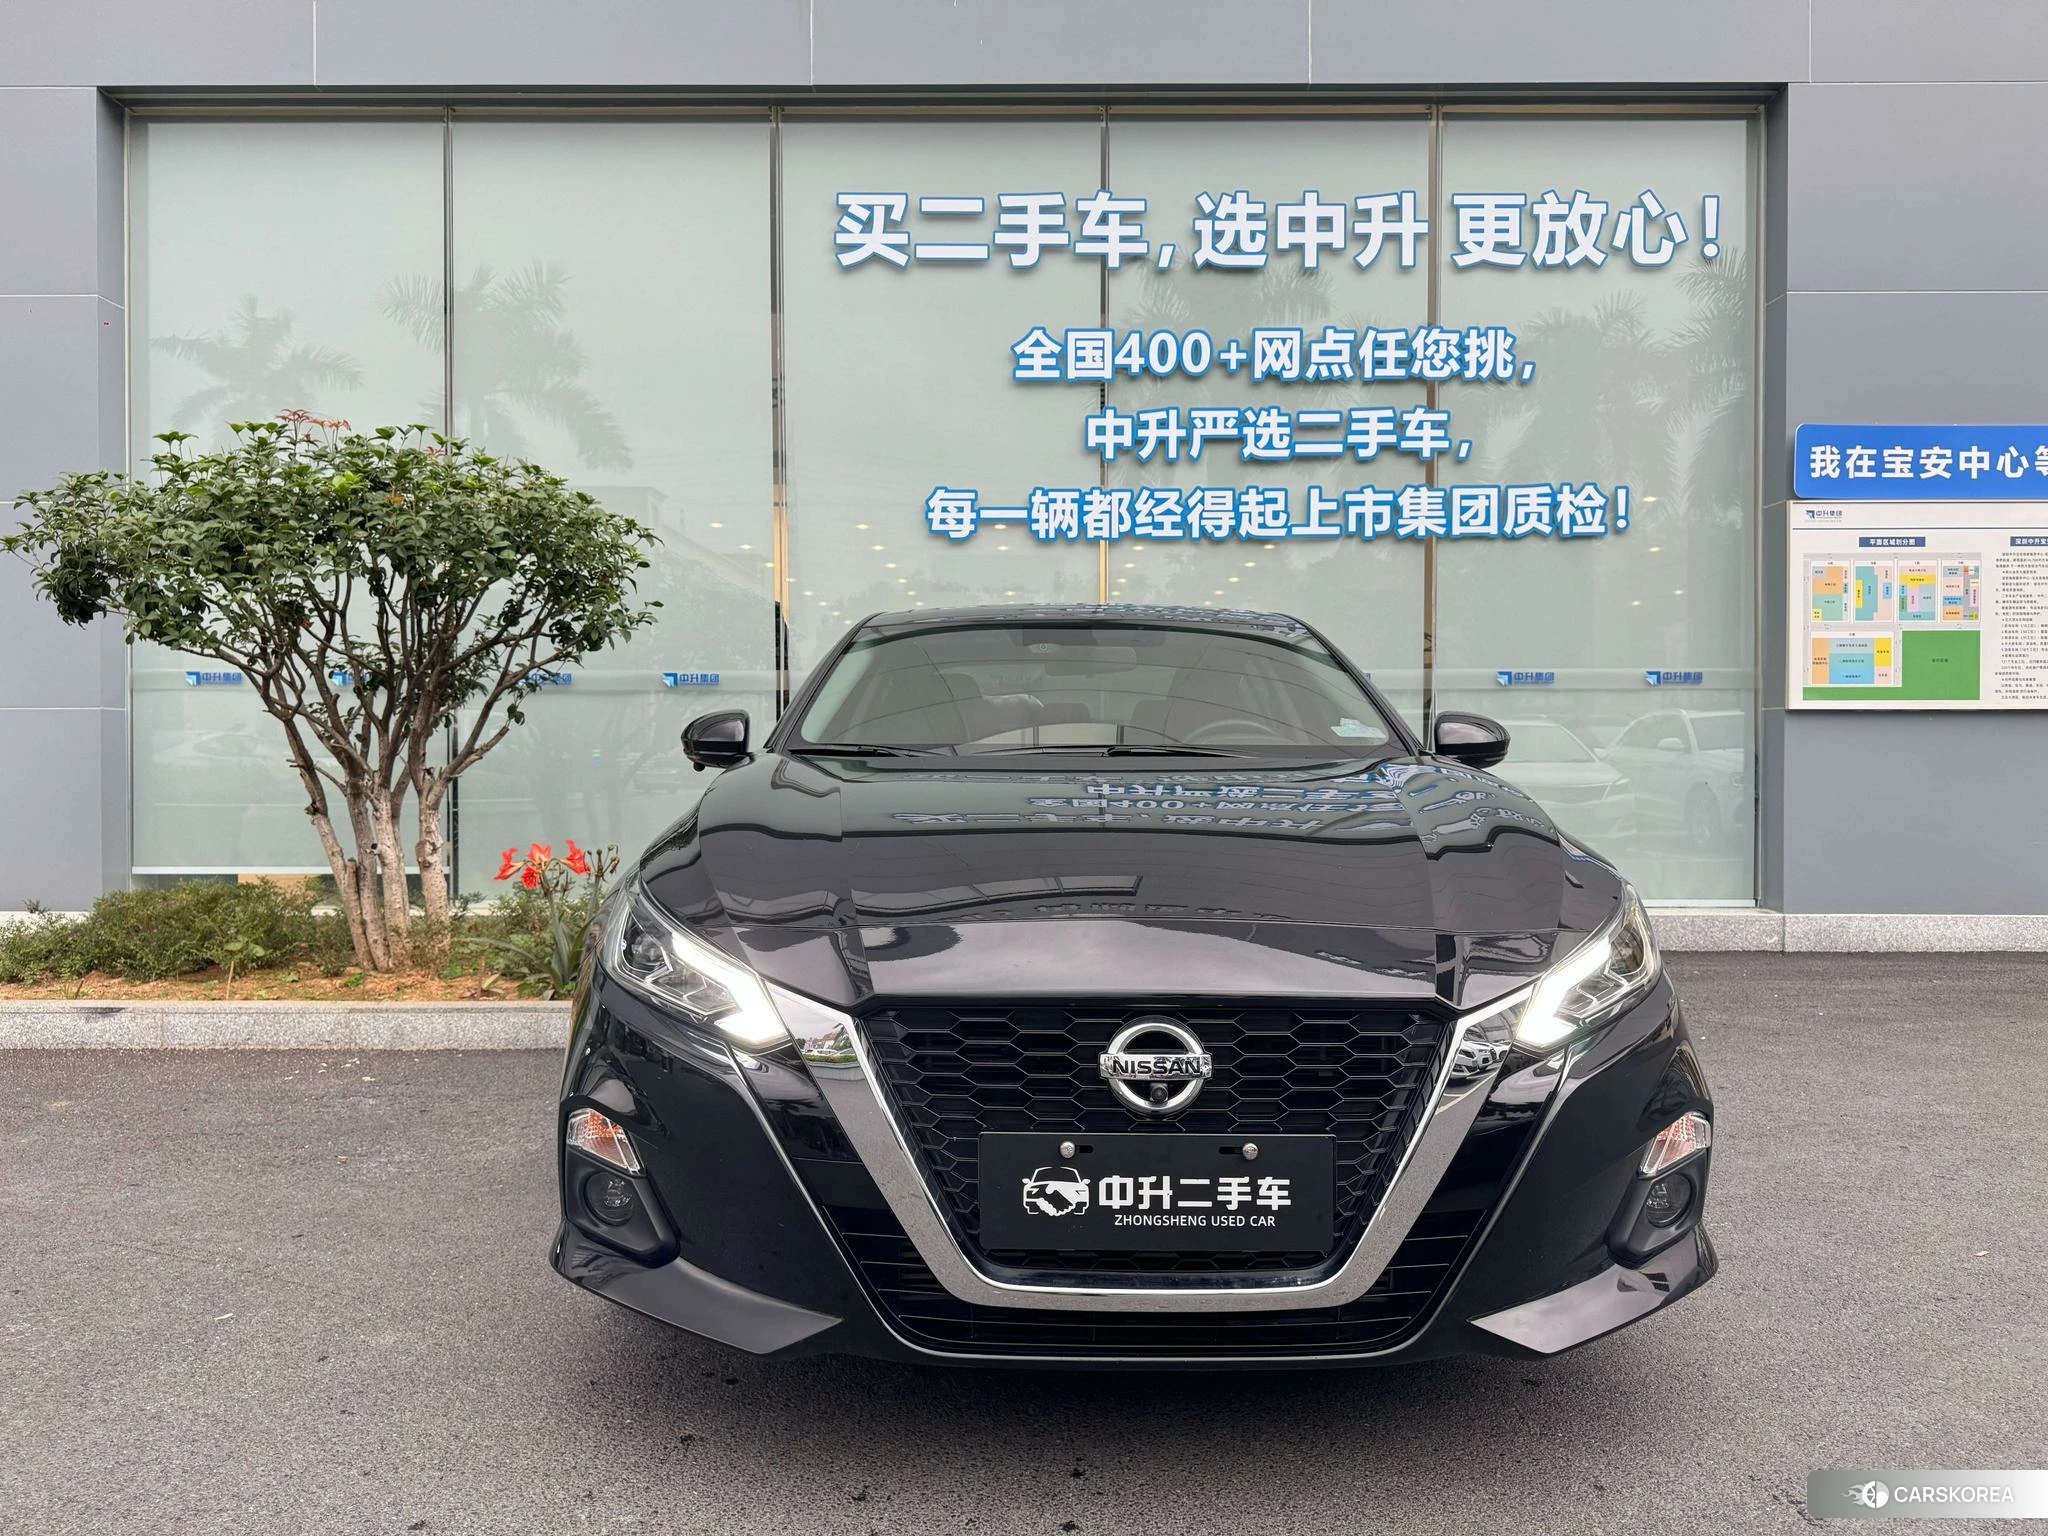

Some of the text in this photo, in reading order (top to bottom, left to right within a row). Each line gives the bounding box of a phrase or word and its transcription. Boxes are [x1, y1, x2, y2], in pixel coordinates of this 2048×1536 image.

[1011, 325, 1537, 385] 全国400+网点任您挑，
[1085, 405, 1473, 465] 中升严选二手车，
[924, 481, 1632, 543] 每一辆都经得起上市集团质检！
[202, 672, 243, 682] 中升集团
[679, 672, 720, 683] 中升集团
[1514, 671, 1555, 682] 中升集团
[1662, 671, 1703, 682] 中升集团
[1112, 1058, 1202, 1075] NISSAN
[1098, 1175, 1292, 1211] 中升二手车
[1114, 1214, 1276, 1227] ZHONGSHENG USED CAR
